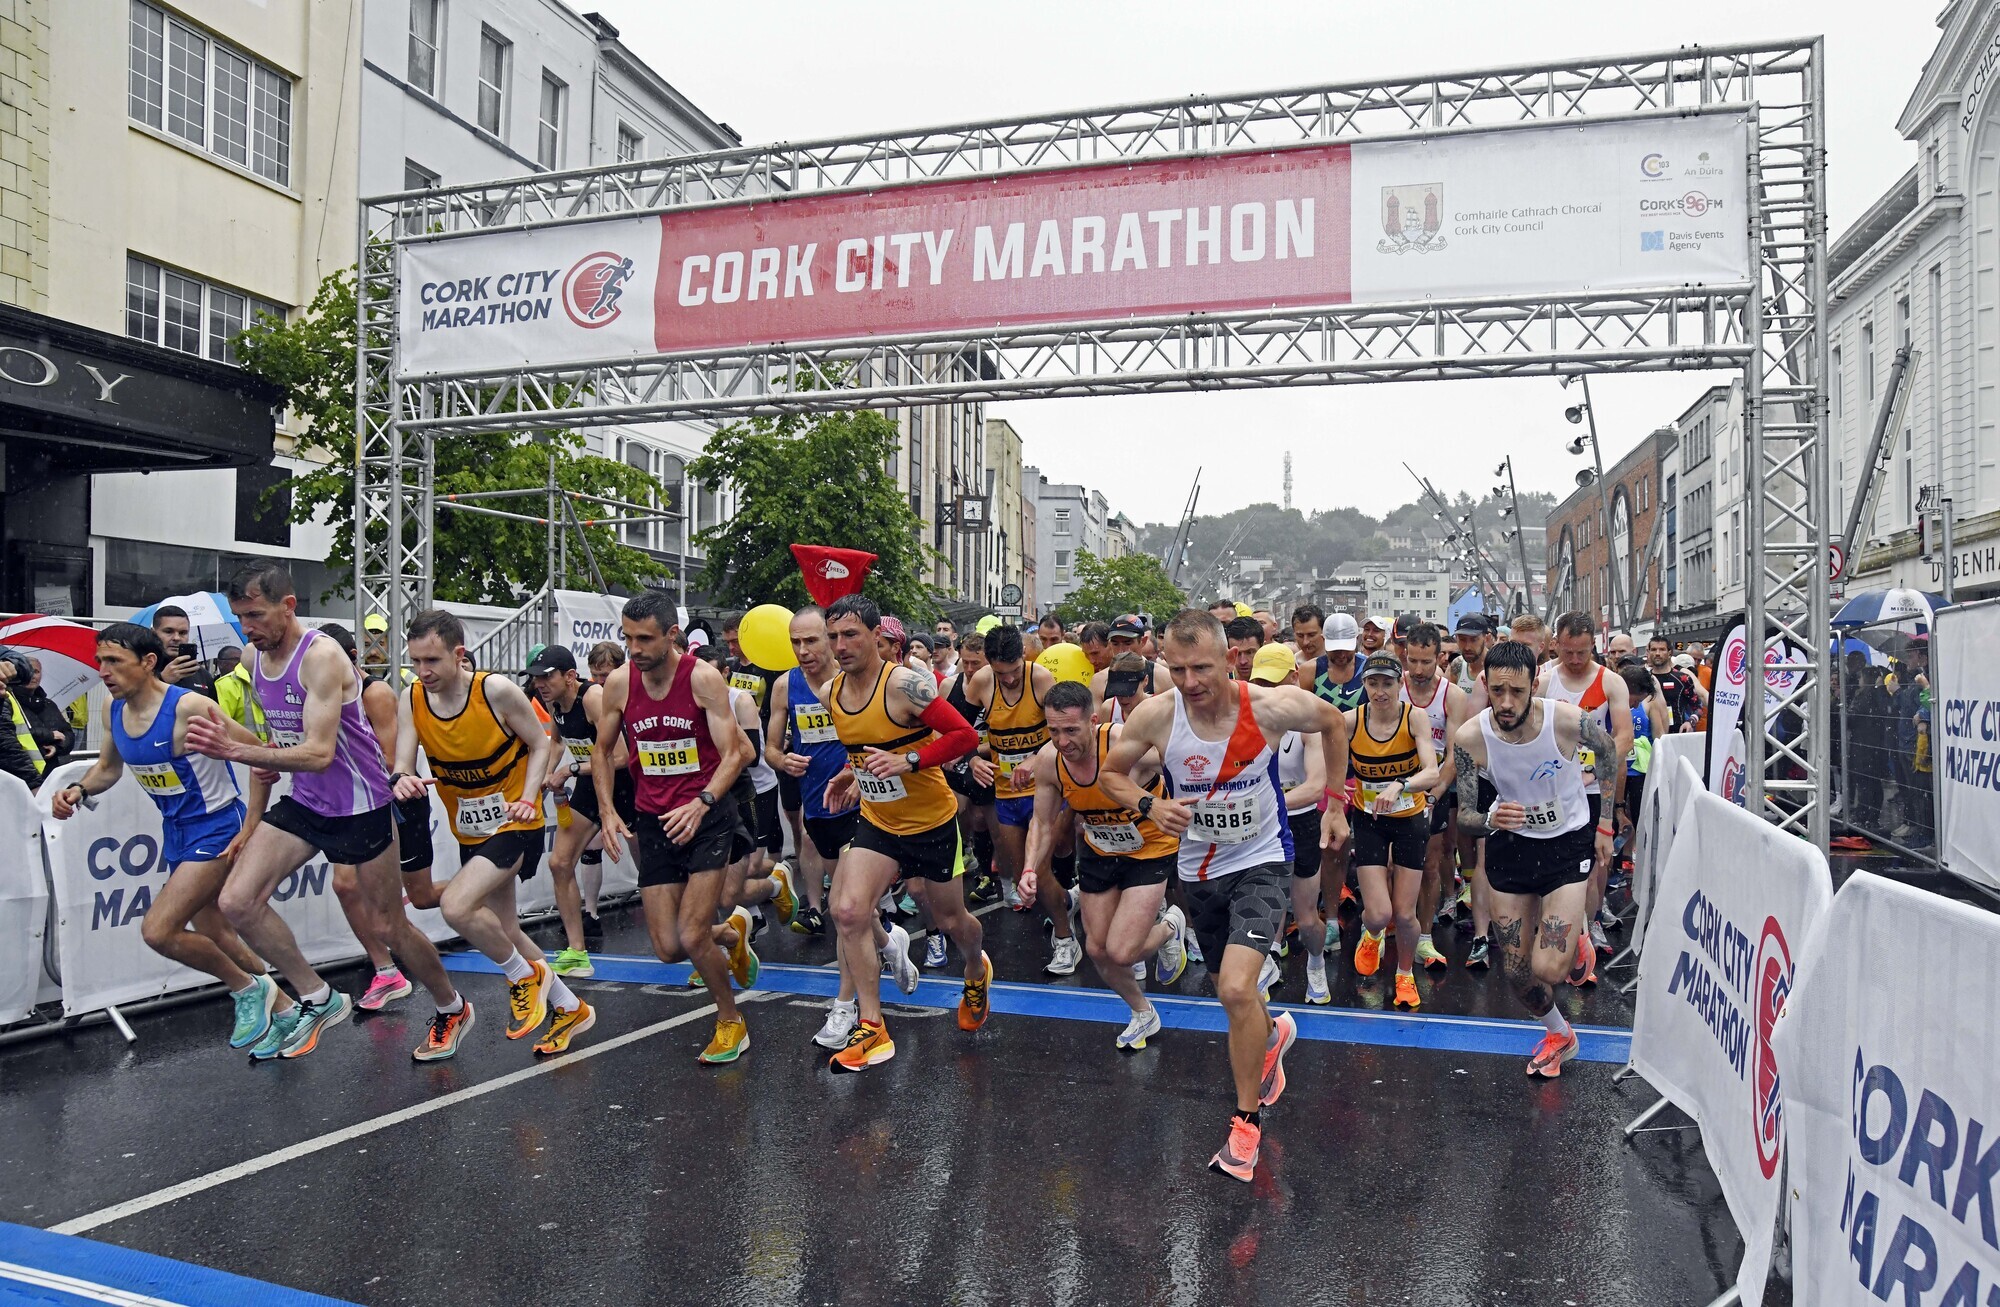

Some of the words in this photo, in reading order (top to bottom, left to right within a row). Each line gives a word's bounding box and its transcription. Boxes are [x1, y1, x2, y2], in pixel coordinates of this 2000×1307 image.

[1684, 168, 1697, 176] An
[1454, 209, 1508, 222] Comhairle
[1511, 206, 1558, 218] Cathrach
[1561, 202, 1602, 215] Chorcaí
[1706, 199, 1723, 208] FM
[1454, 225, 1478, 235] Cork
[1481, 224, 1500, 235] City
[1504, 220, 1544, 233] Council
[1669, 232, 1692, 240] Davis
[1695, 231, 1724, 239] Events
[678, 242, 818, 308] CORK
[835, 227, 954, 293] CITY
[972, 198, 1315, 283] MARATHON
[1669, 241, 1701, 252] Agency
[420, 276, 491, 305] CORK
[497, 268, 560, 302] CITY
[421, 297, 552, 332] MARATHON
[1931, 546, 2000, 583] DBENH
[572, 619, 614, 641] CORK
[632, 716, 658, 734] EAST
[662, 715, 694, 731] CORK
[807, 713, 833, 729] 131
[1945, 699, 1979, 738] CORK
[995, 732, 1044, 748] LEEVALE
[648, 751, 688, 767] 1889
[1354, 759, 1415, 777] LEEVALE
[139, 774, 167, 788] 787
[443, 767, 493, 783] LEEVALE
[1179, 783, 1212, 793] GRANGE
[1213, 779, 1248, 792] FERMOY
[459, 805, 504, 825] A8132
[1193, 810, 1252, 828] A8385
[1524, 810, 1557, 825] 358
[1092, 831, 1136, 842] A8134
[1682, 889, 1722, 966] CORK
[1724, 920, 1755, 1004] CITY
[1667, 951, 1751, 1082] MARATHON
[1852, 1045, 2000, 1252] CORK
